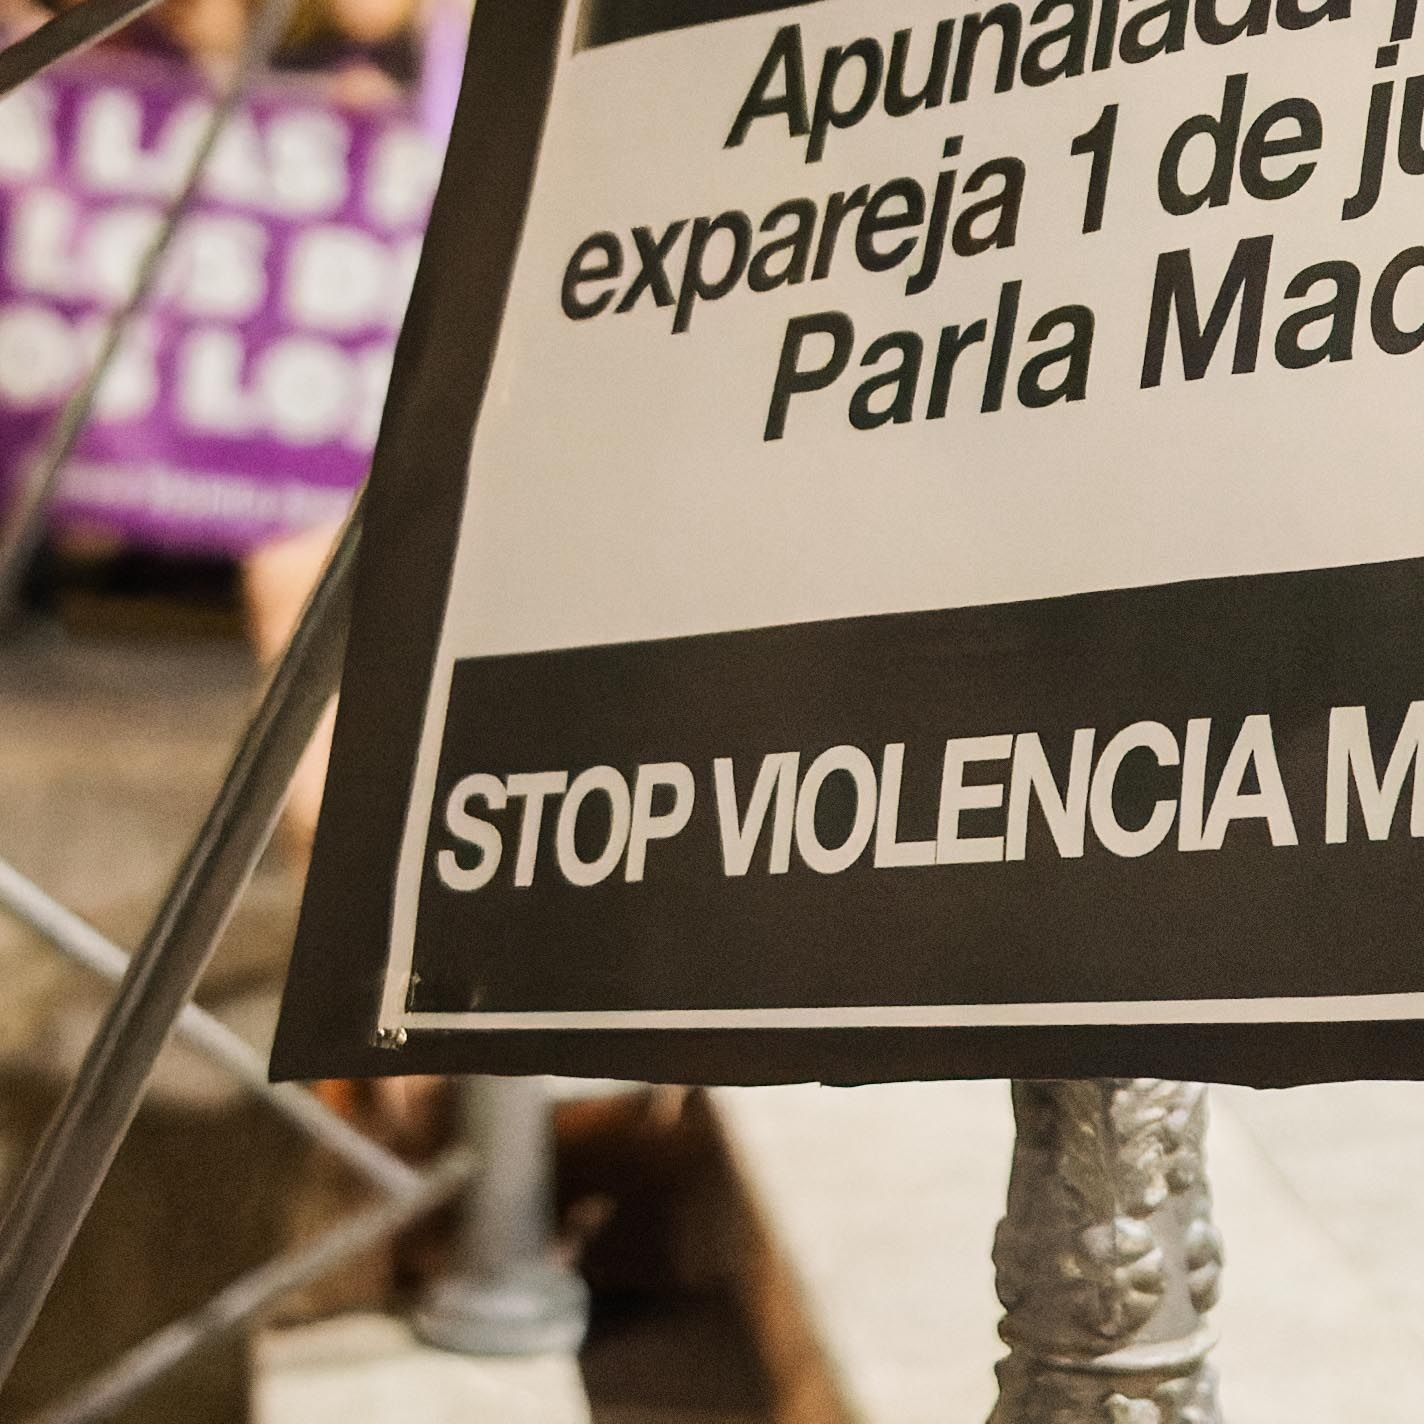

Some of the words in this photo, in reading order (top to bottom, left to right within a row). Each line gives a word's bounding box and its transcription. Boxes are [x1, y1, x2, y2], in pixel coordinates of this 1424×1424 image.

[559, 136, 1027, 336] expareja
[1069, 102, 1120, 236] 1
[1156, 71, 1324, 218] de
[762, 278, 1096, 443] Parla
[436, 760, 697, 893] STOP
[712, 712, 1300, 878] VIOLENCIA
